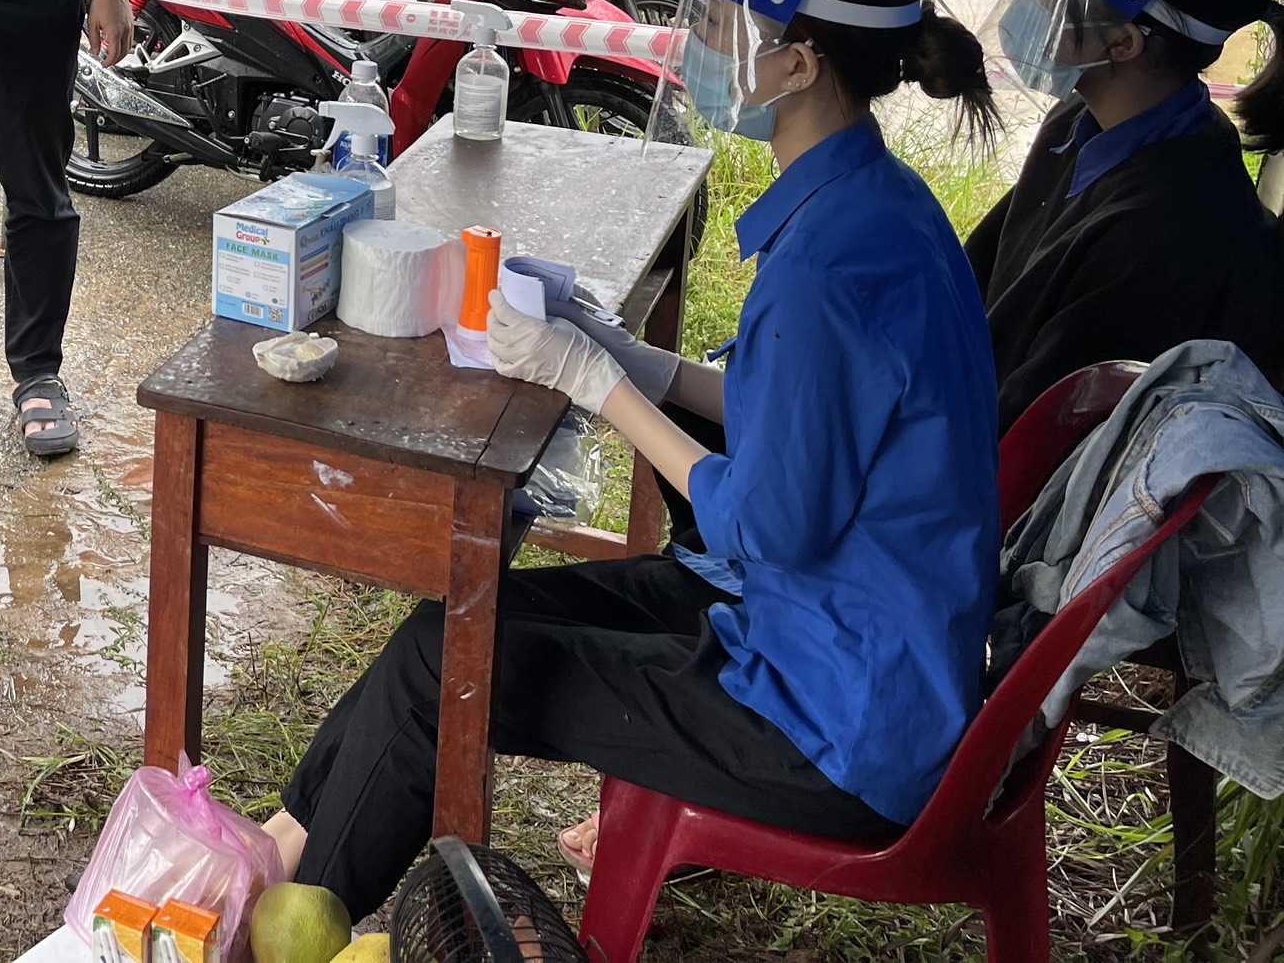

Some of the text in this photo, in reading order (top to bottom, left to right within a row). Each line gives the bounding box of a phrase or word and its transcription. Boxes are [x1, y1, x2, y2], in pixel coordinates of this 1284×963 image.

[236, 221, 269, 237] Medical
[226, 242, 279, 261] FACE MASK
